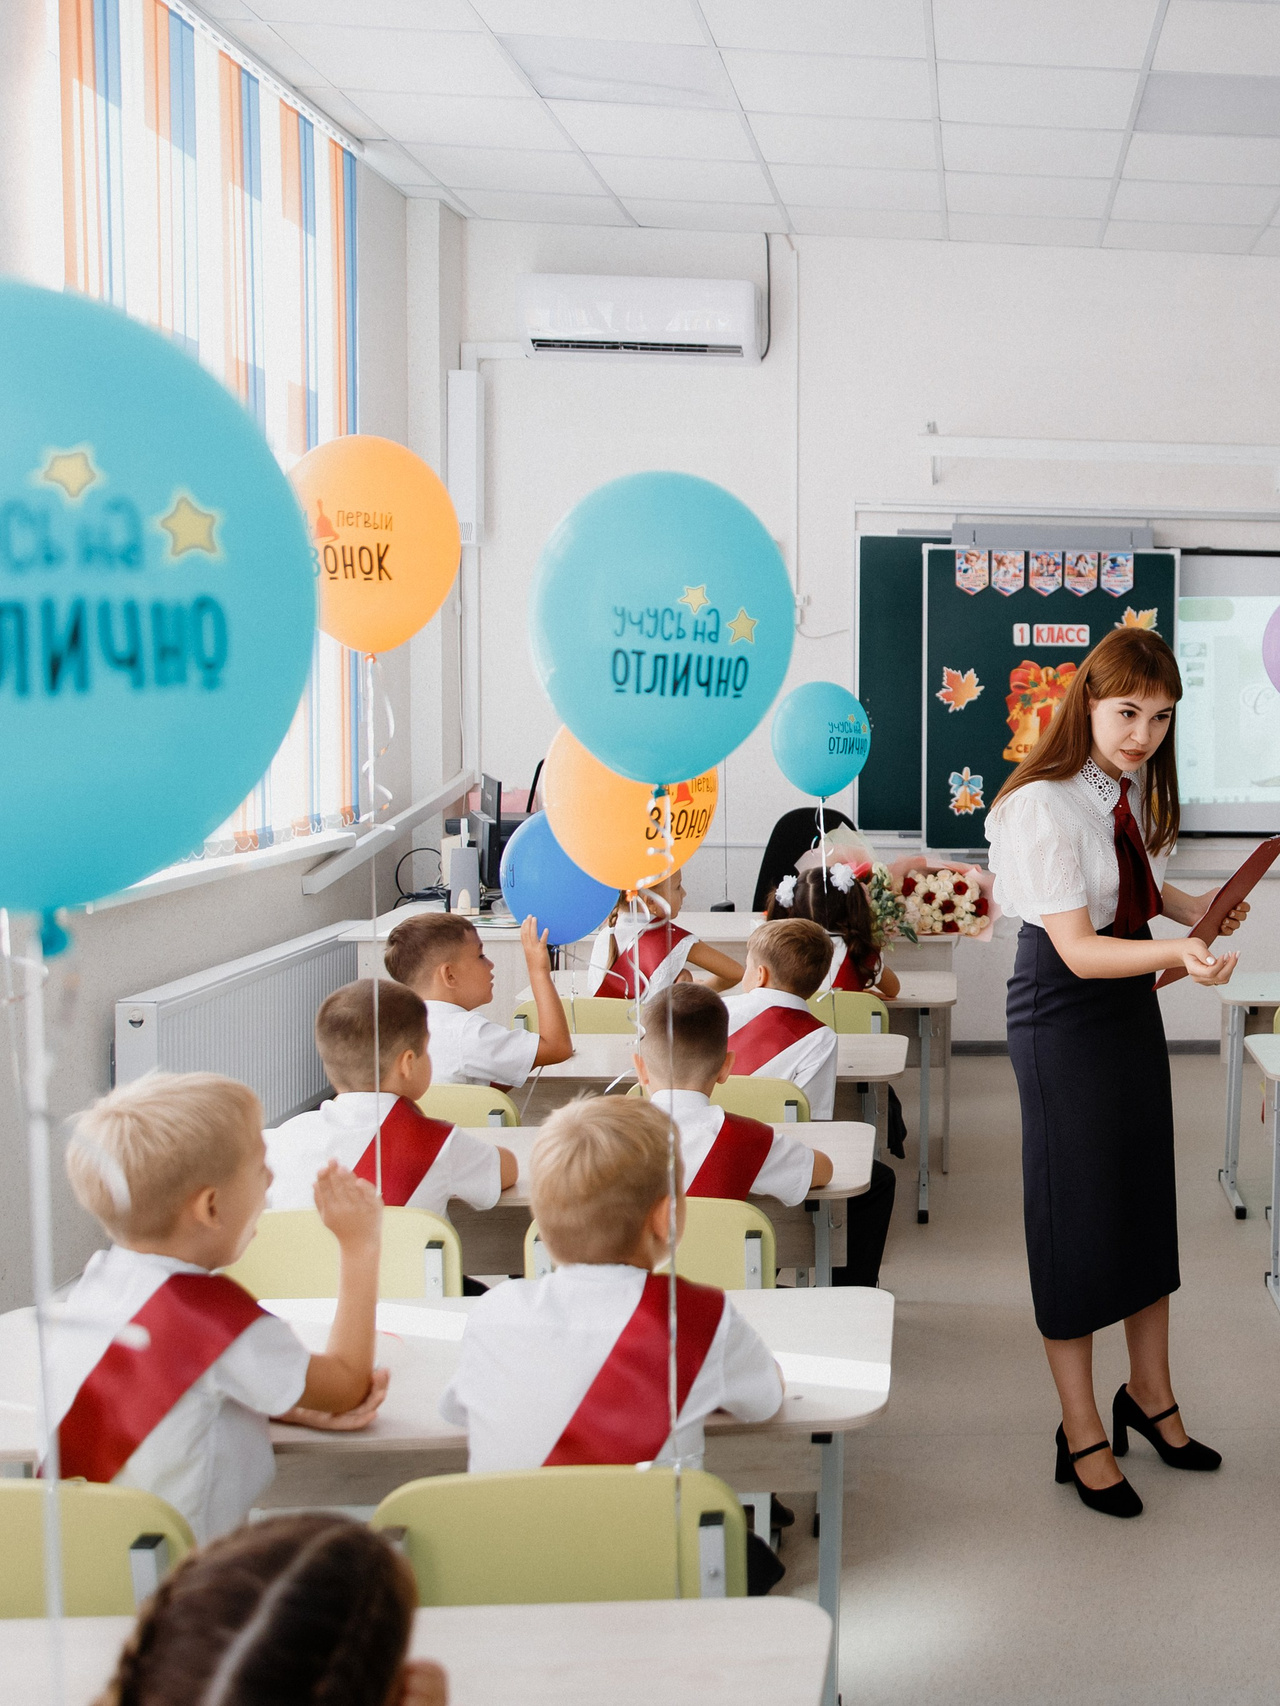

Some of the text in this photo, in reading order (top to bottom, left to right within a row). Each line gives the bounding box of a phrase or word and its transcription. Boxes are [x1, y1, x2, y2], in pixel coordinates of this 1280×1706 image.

[614, 606, 686, 641] УЧУСЬ
[1036, 626, 1087, 643] КЛАСС
[612, 648, 749, 698] ОТЛИЧНО
